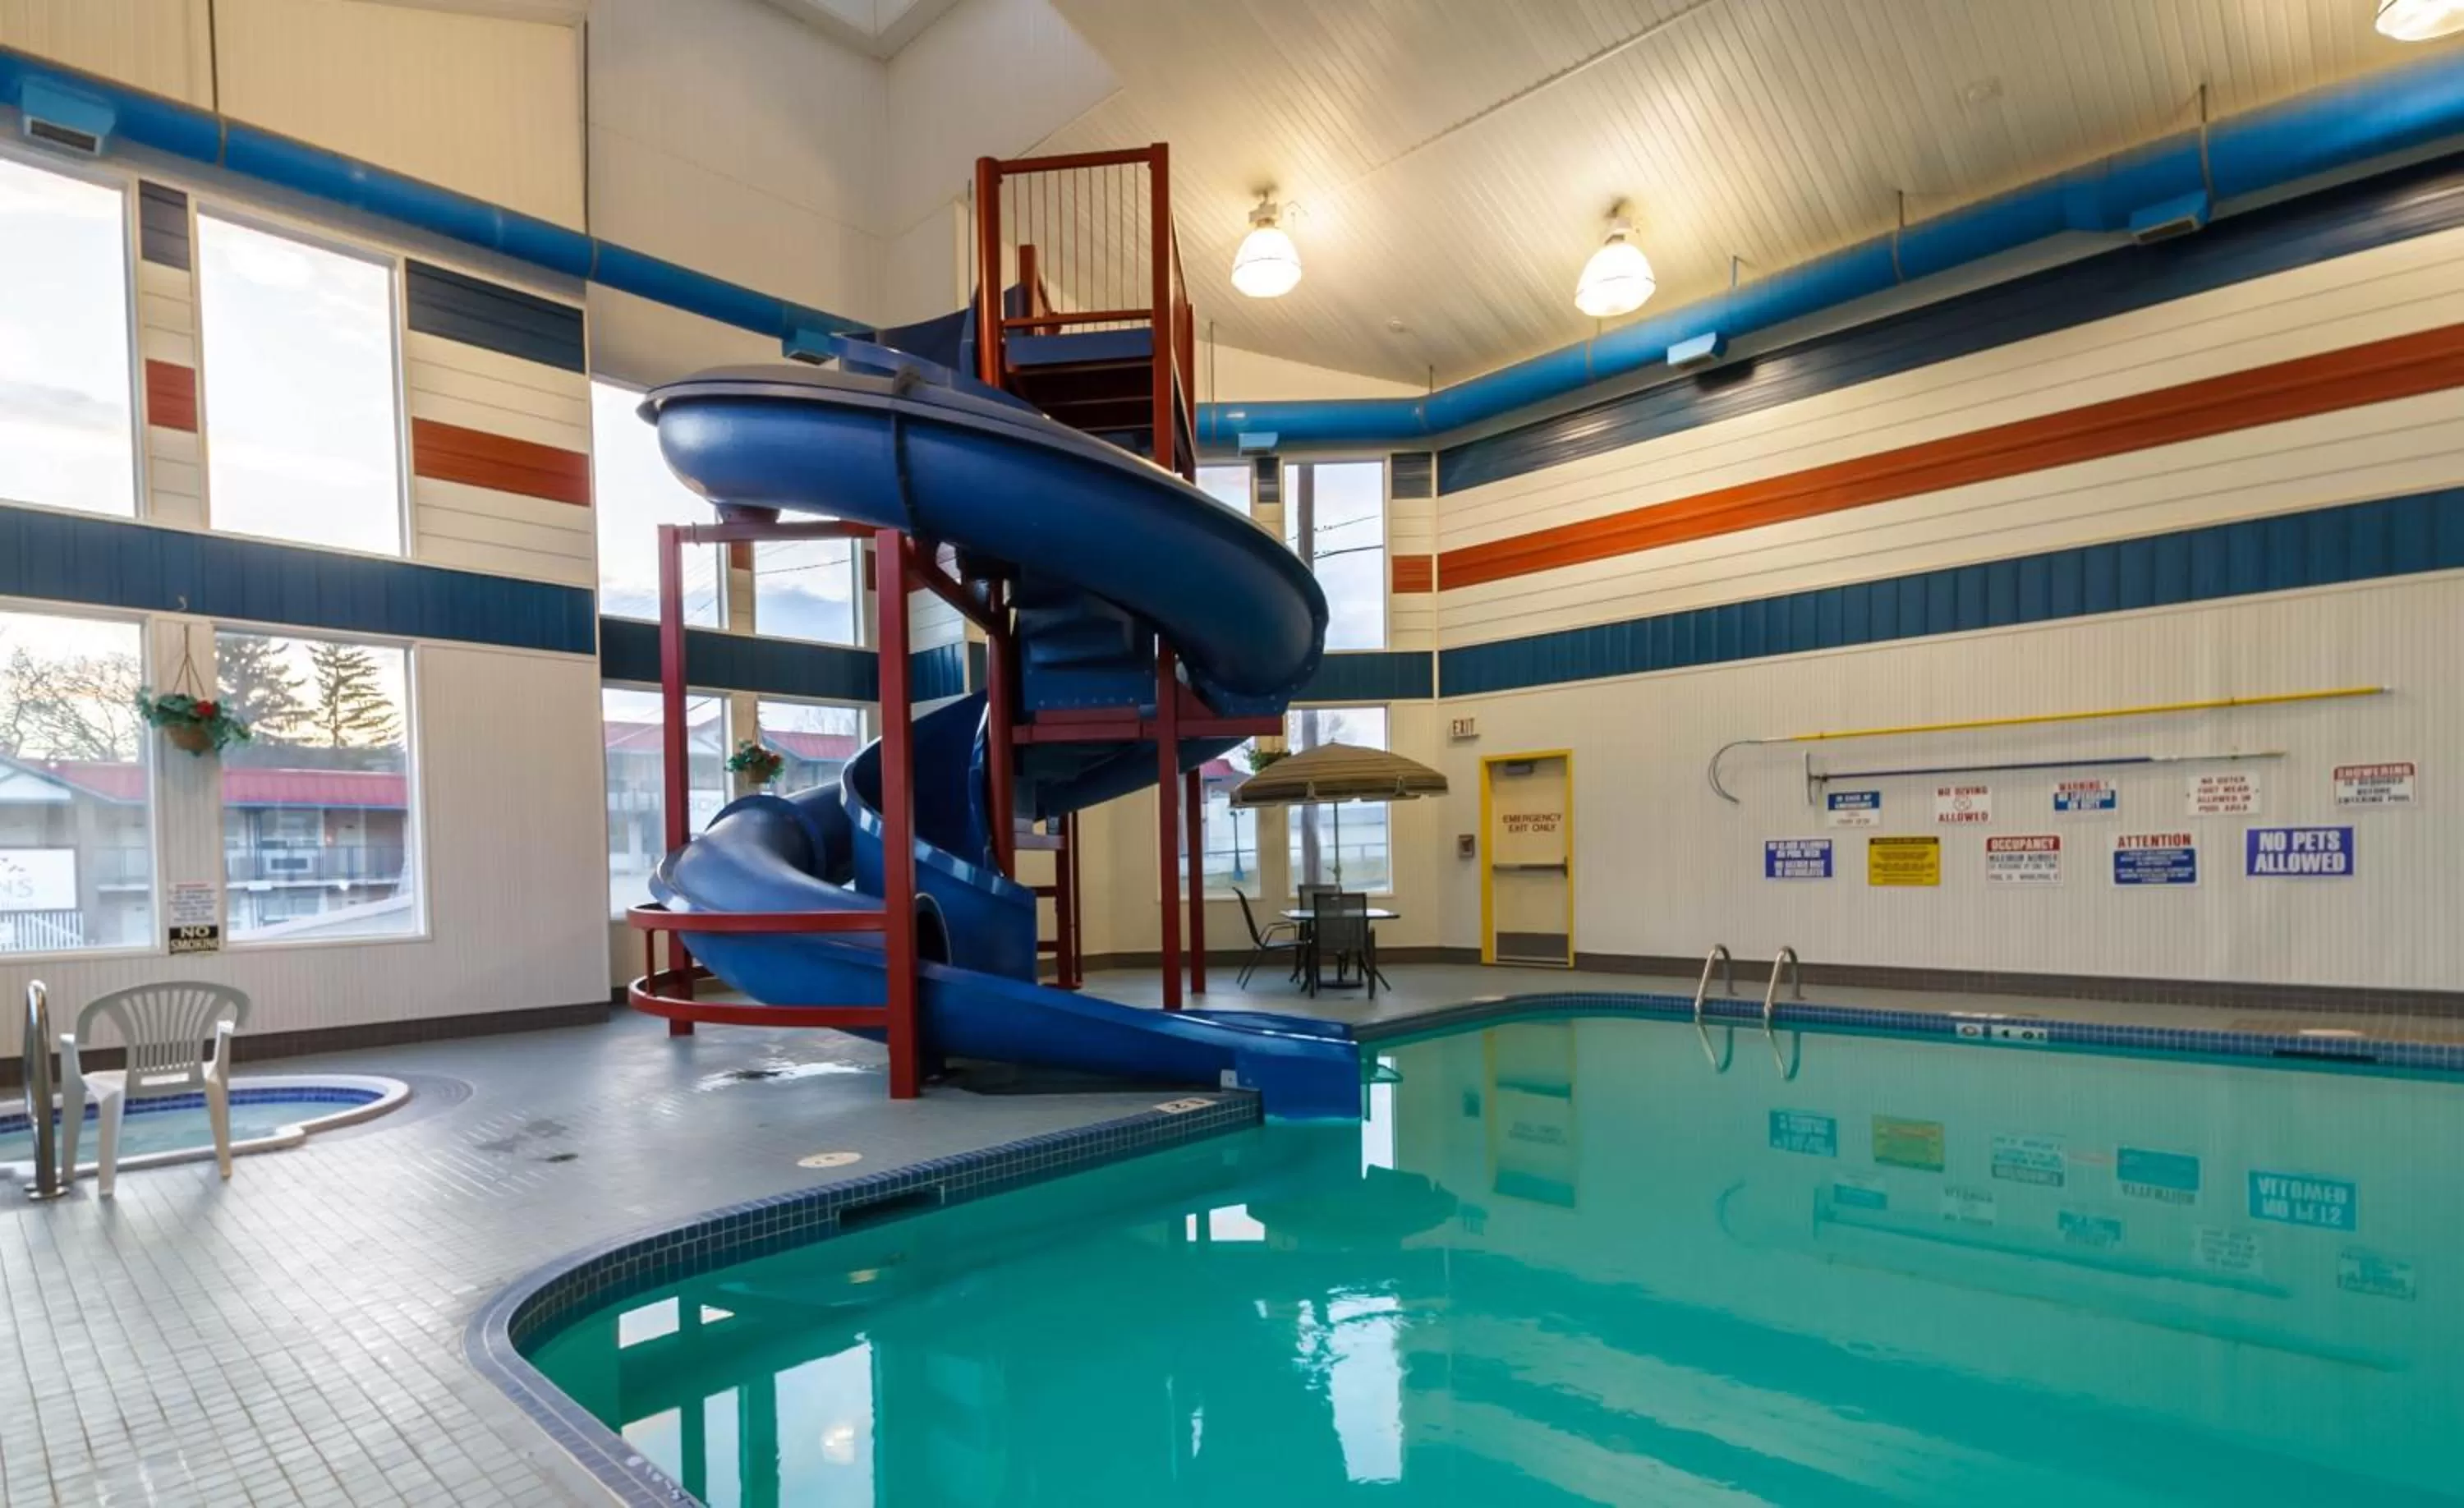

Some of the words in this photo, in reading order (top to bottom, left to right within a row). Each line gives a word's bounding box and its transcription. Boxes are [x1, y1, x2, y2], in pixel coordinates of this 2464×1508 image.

[1452, 718, 1475, 737] EXIT
[1938, 787, 1951, 797] NO
[1954, 785, 1988, 796] DIVING
[1503, 813, 1562, 824] EMERGENCY
[1938, 811, 1988, 822] ALLOWED
[1509, 824, 1528, 834] EXIT
[1532, 824, 1557, 832] ONLY
[1991, 838, 2054, 850] OCCUPANCY
[2118, 834, 2191, 848] ATTENTION
[2259, 832, 2286, 851] NO
[2292, 830, 2341, 850] PETS
[2254, 853, 2346, 873] ALLOWED
[181, 926, 210, 938] NO
